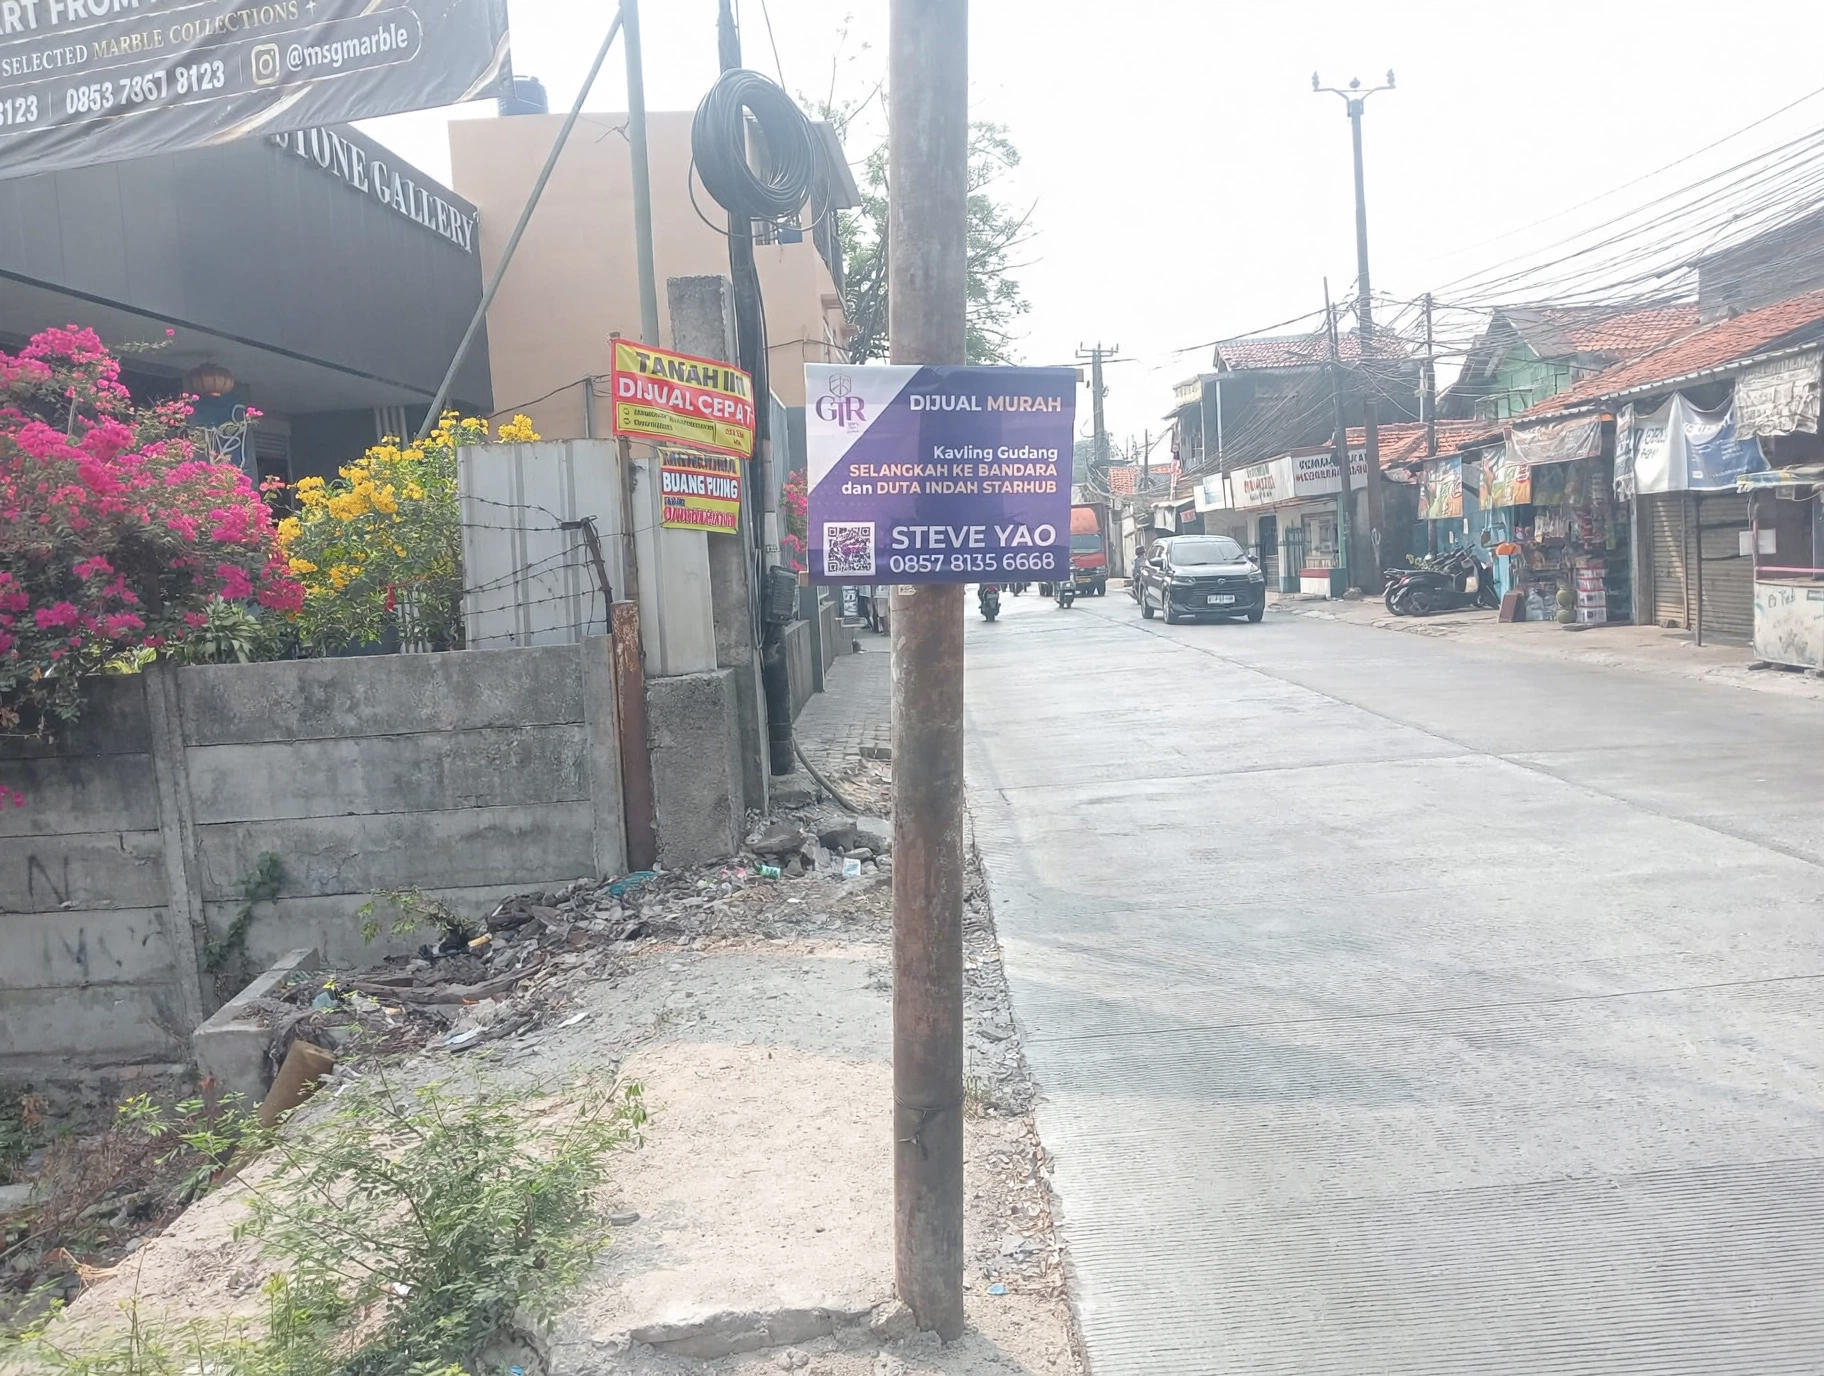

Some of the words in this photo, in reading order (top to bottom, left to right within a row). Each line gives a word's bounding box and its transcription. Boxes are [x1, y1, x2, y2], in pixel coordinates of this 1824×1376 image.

[0, 0, 39, 35] RT
[2, 44, 88, 77] SELECTED
[92, 29, 164, 60] MARBLE
[169, 1, 298, 44] COLLECTIONS
[66, 81, 114, 115] 0853
[174, 60, 225, 94] 8123
[286, 23, 408, 72] @msgmarble
[371, 161, 473, 254] GALLERY
[635, 351, 718, 389] TANAH
[619, 377, 694, 411] DIJUAL
[698, 395, 754, 425] CEPAT
[816, 395, 867, 427] GTR
[910, 395, 981, 411] DIJUAL
[987, 395, 1061, 412] MURAH
[934, 445, 993, 462] Kavling
[997, 445, 1058, 462] Gudang
[662, 472, 706, 494] BUANG
[849, 464, 948, 477] SELANGKAH
[953, 464, 973, 476] KE
[978, 463, 1057, 477] BANDARA
[842, 481, 873, 495] dan
[876, 481, 922, 495] DUTA
[926, 481, 978, 494] INDAH
[982, 480, 1057, 494] STARHUB
[892, 525, 986, 549] STEVE
[994, 523, 1056, 548] YAO
[890, 554, 944, 573] 0857
[950, 553, 997, 572] 8135
[1002, 552, 1055, 571] 6668
